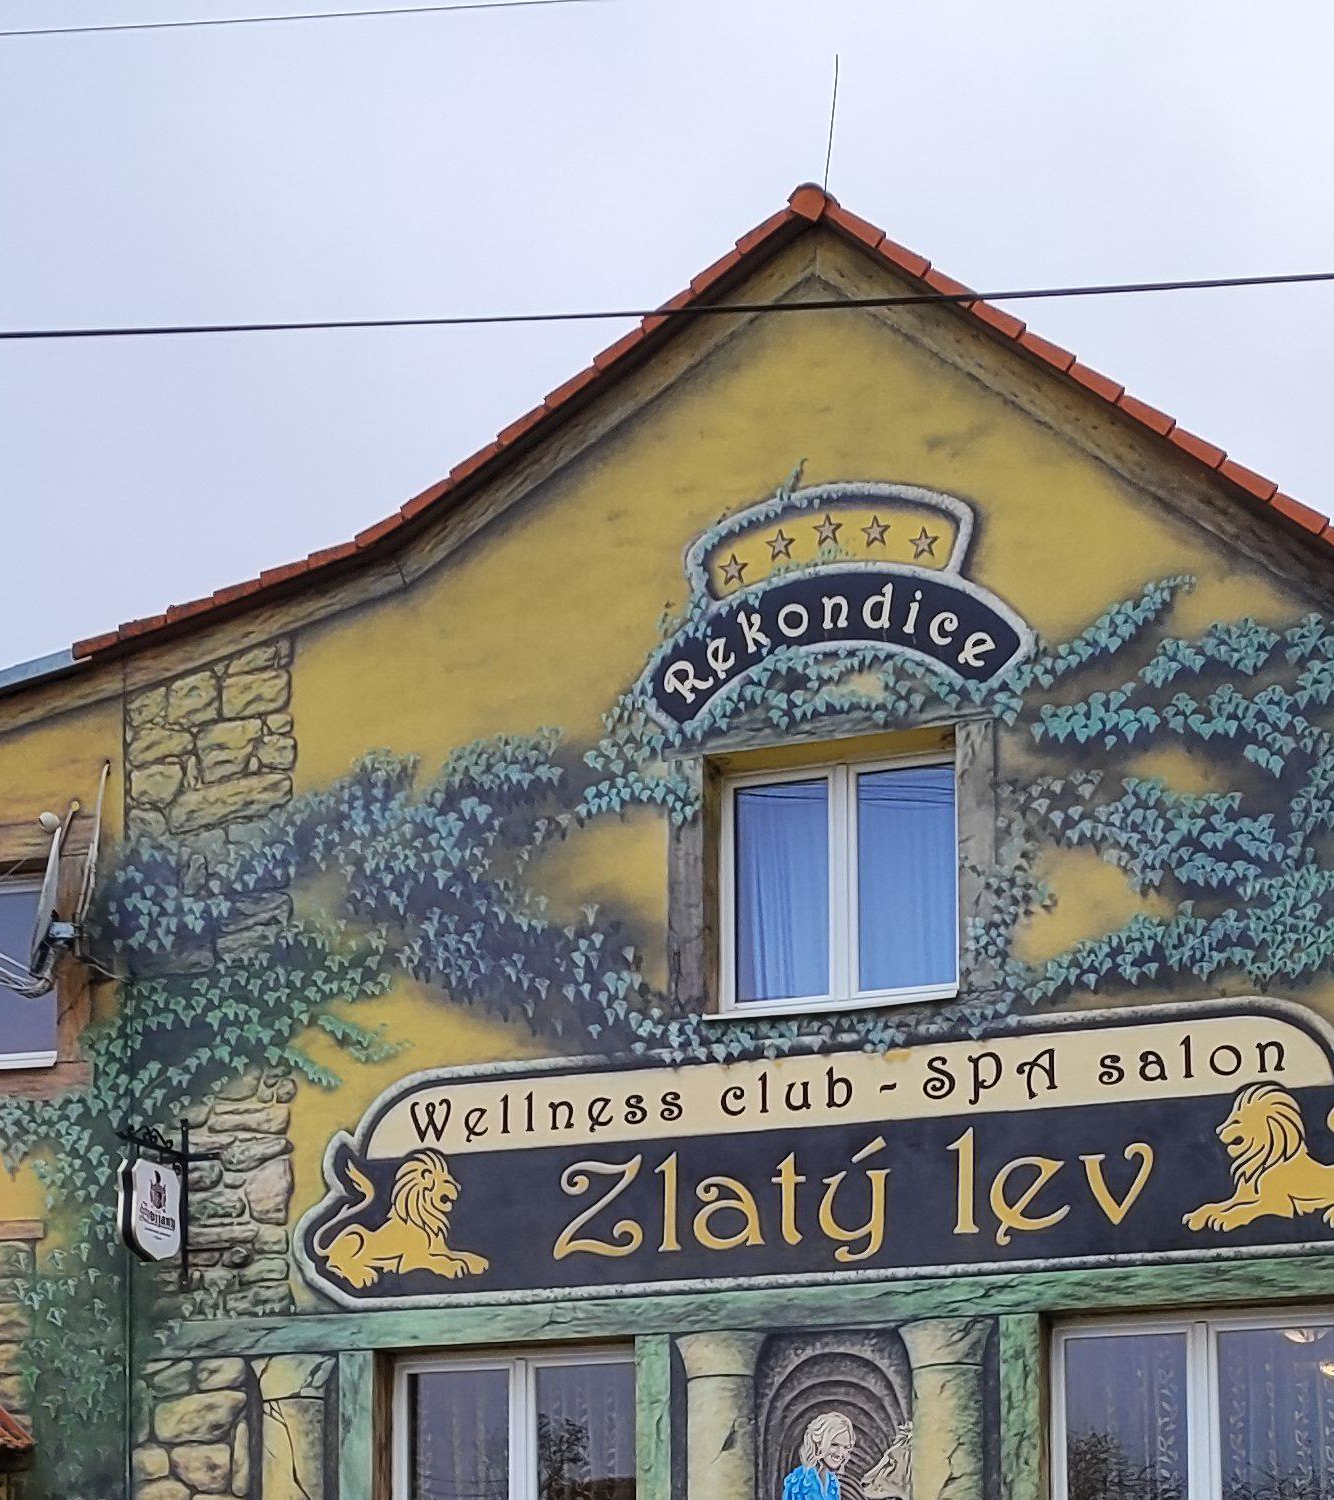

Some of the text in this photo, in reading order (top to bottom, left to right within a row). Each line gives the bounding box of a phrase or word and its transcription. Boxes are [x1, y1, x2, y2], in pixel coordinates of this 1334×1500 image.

[664, 582, 996, 704] Rekondice
[410, 1091, 683, 1143] Wellness
[719, 1066, 853, 1116] club
[922, 1048, 1058, 1105] SPA
[1098, 1035, 1285, 1085] salon
[552, 1126, 1154, 1262] Zlatý lev
